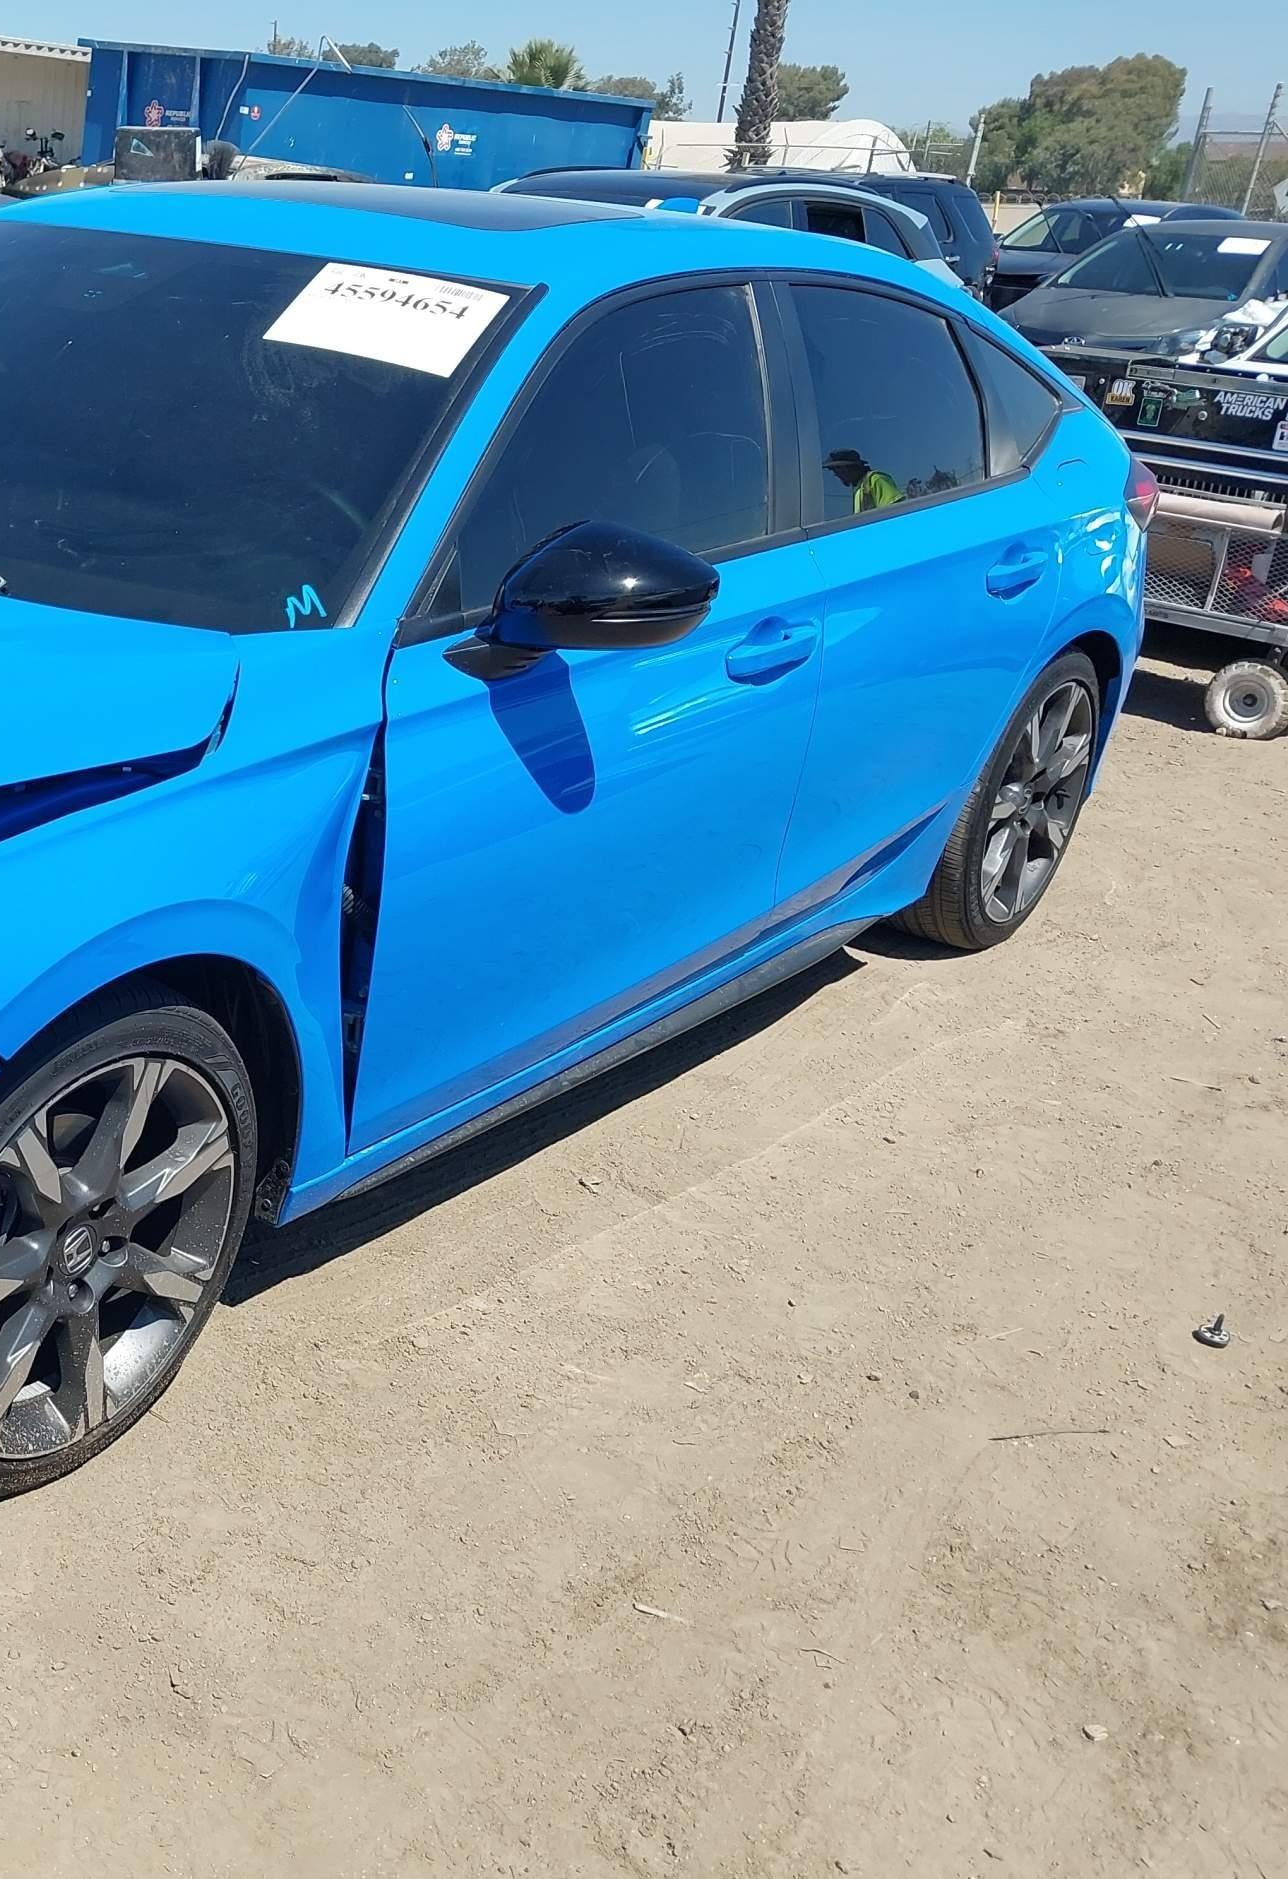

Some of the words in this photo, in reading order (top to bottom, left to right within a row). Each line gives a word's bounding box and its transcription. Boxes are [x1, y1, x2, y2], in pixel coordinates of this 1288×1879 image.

[324, 280, 470, 320] 45594654
[1214, 391, 1287, 410] AMERICAN
[1220, 403, 1274, 420] TRUCKS
